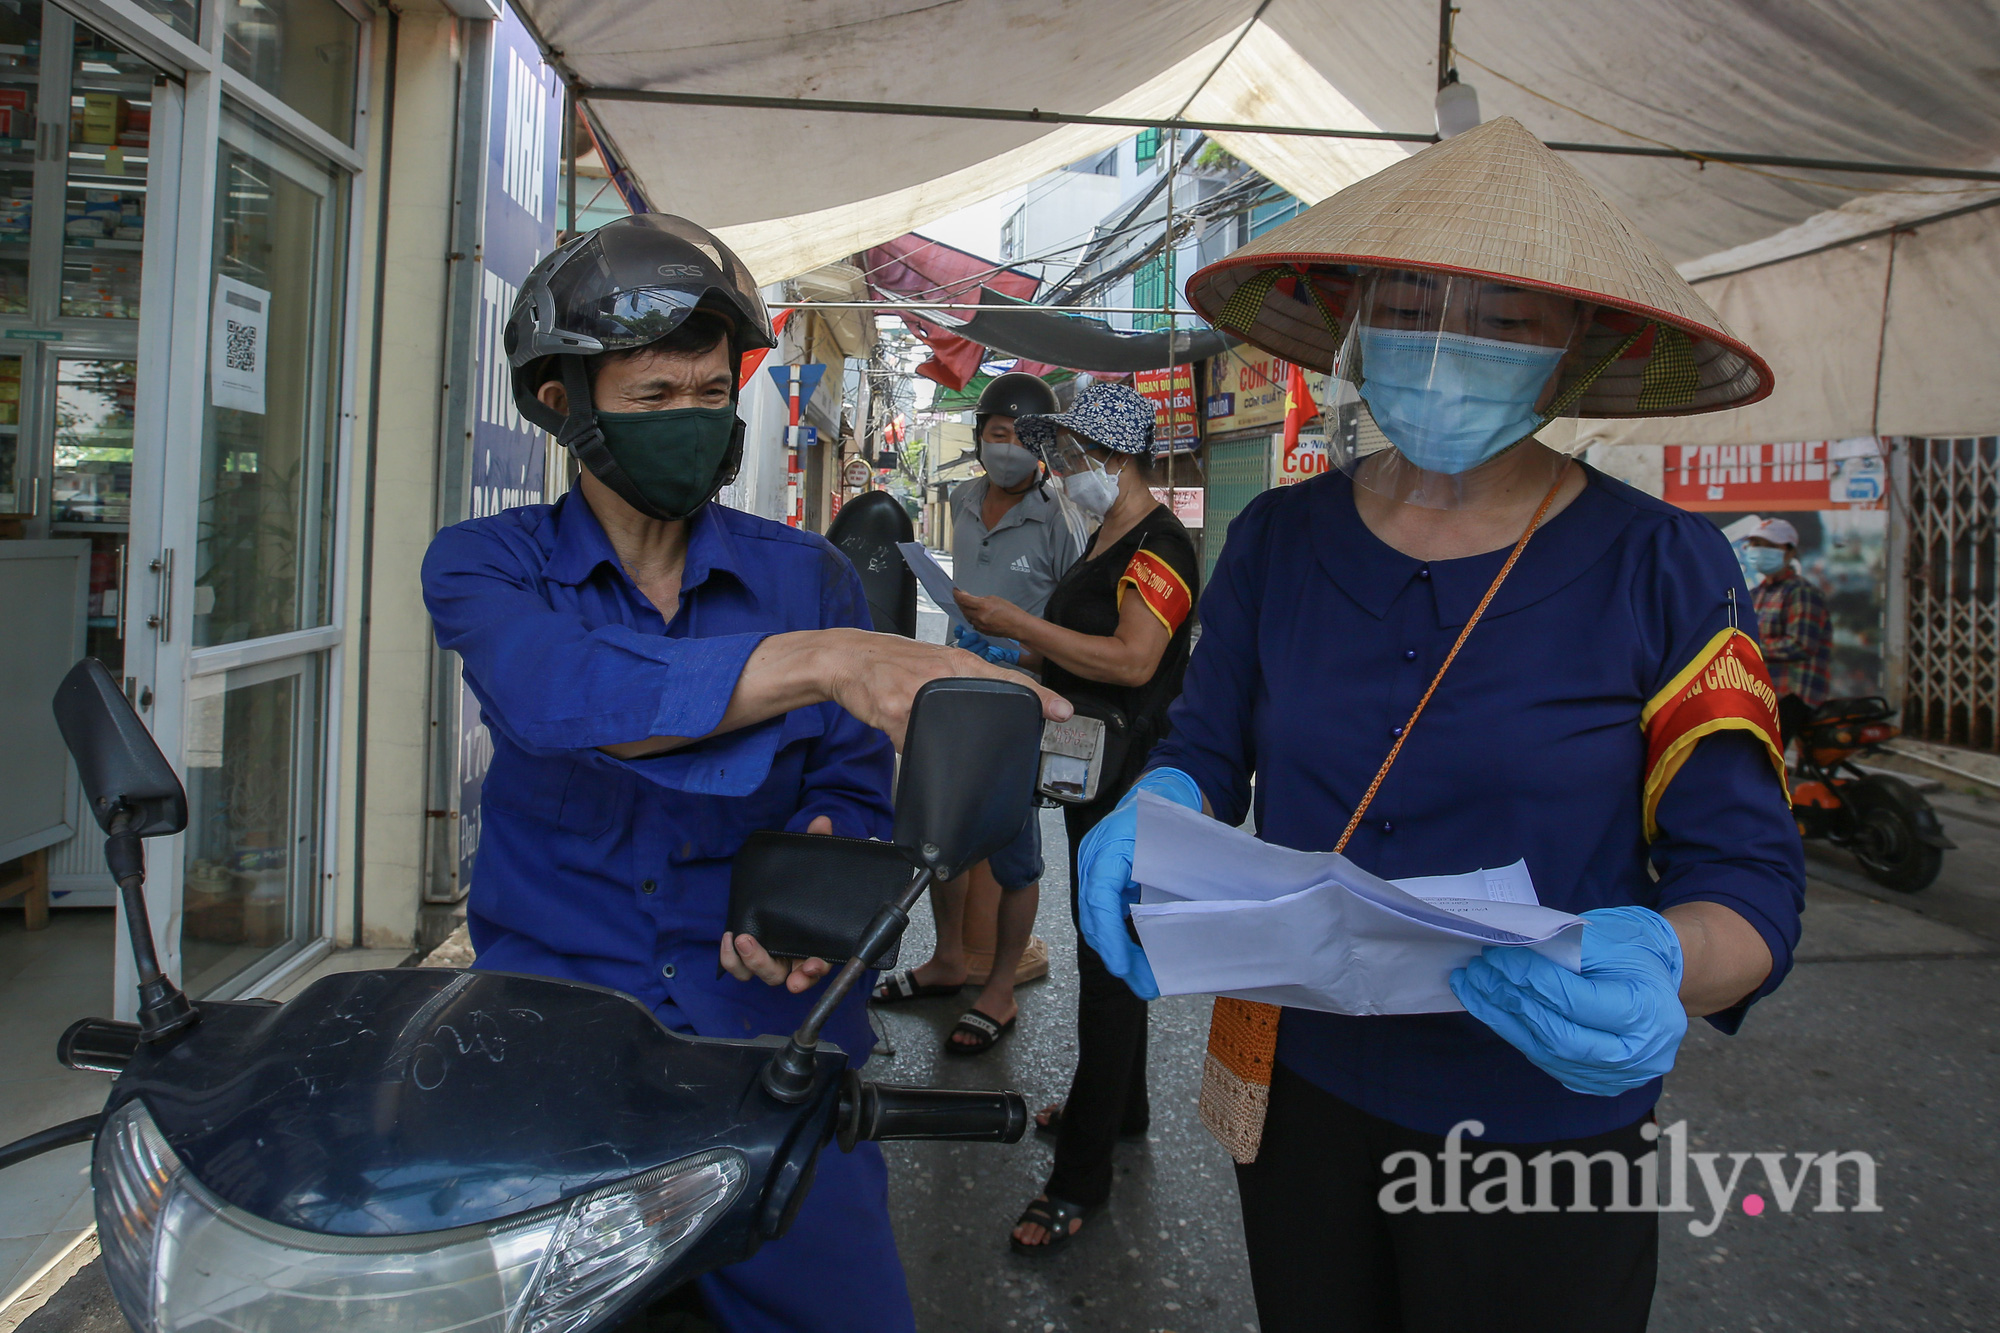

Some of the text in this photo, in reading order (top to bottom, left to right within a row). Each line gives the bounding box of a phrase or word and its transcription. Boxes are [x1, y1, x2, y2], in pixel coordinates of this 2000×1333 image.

[658, 264, 704, 276] GRS
[1148, 573, 1167, 593] COVID
[1162, 585, 1174, 600] 19
